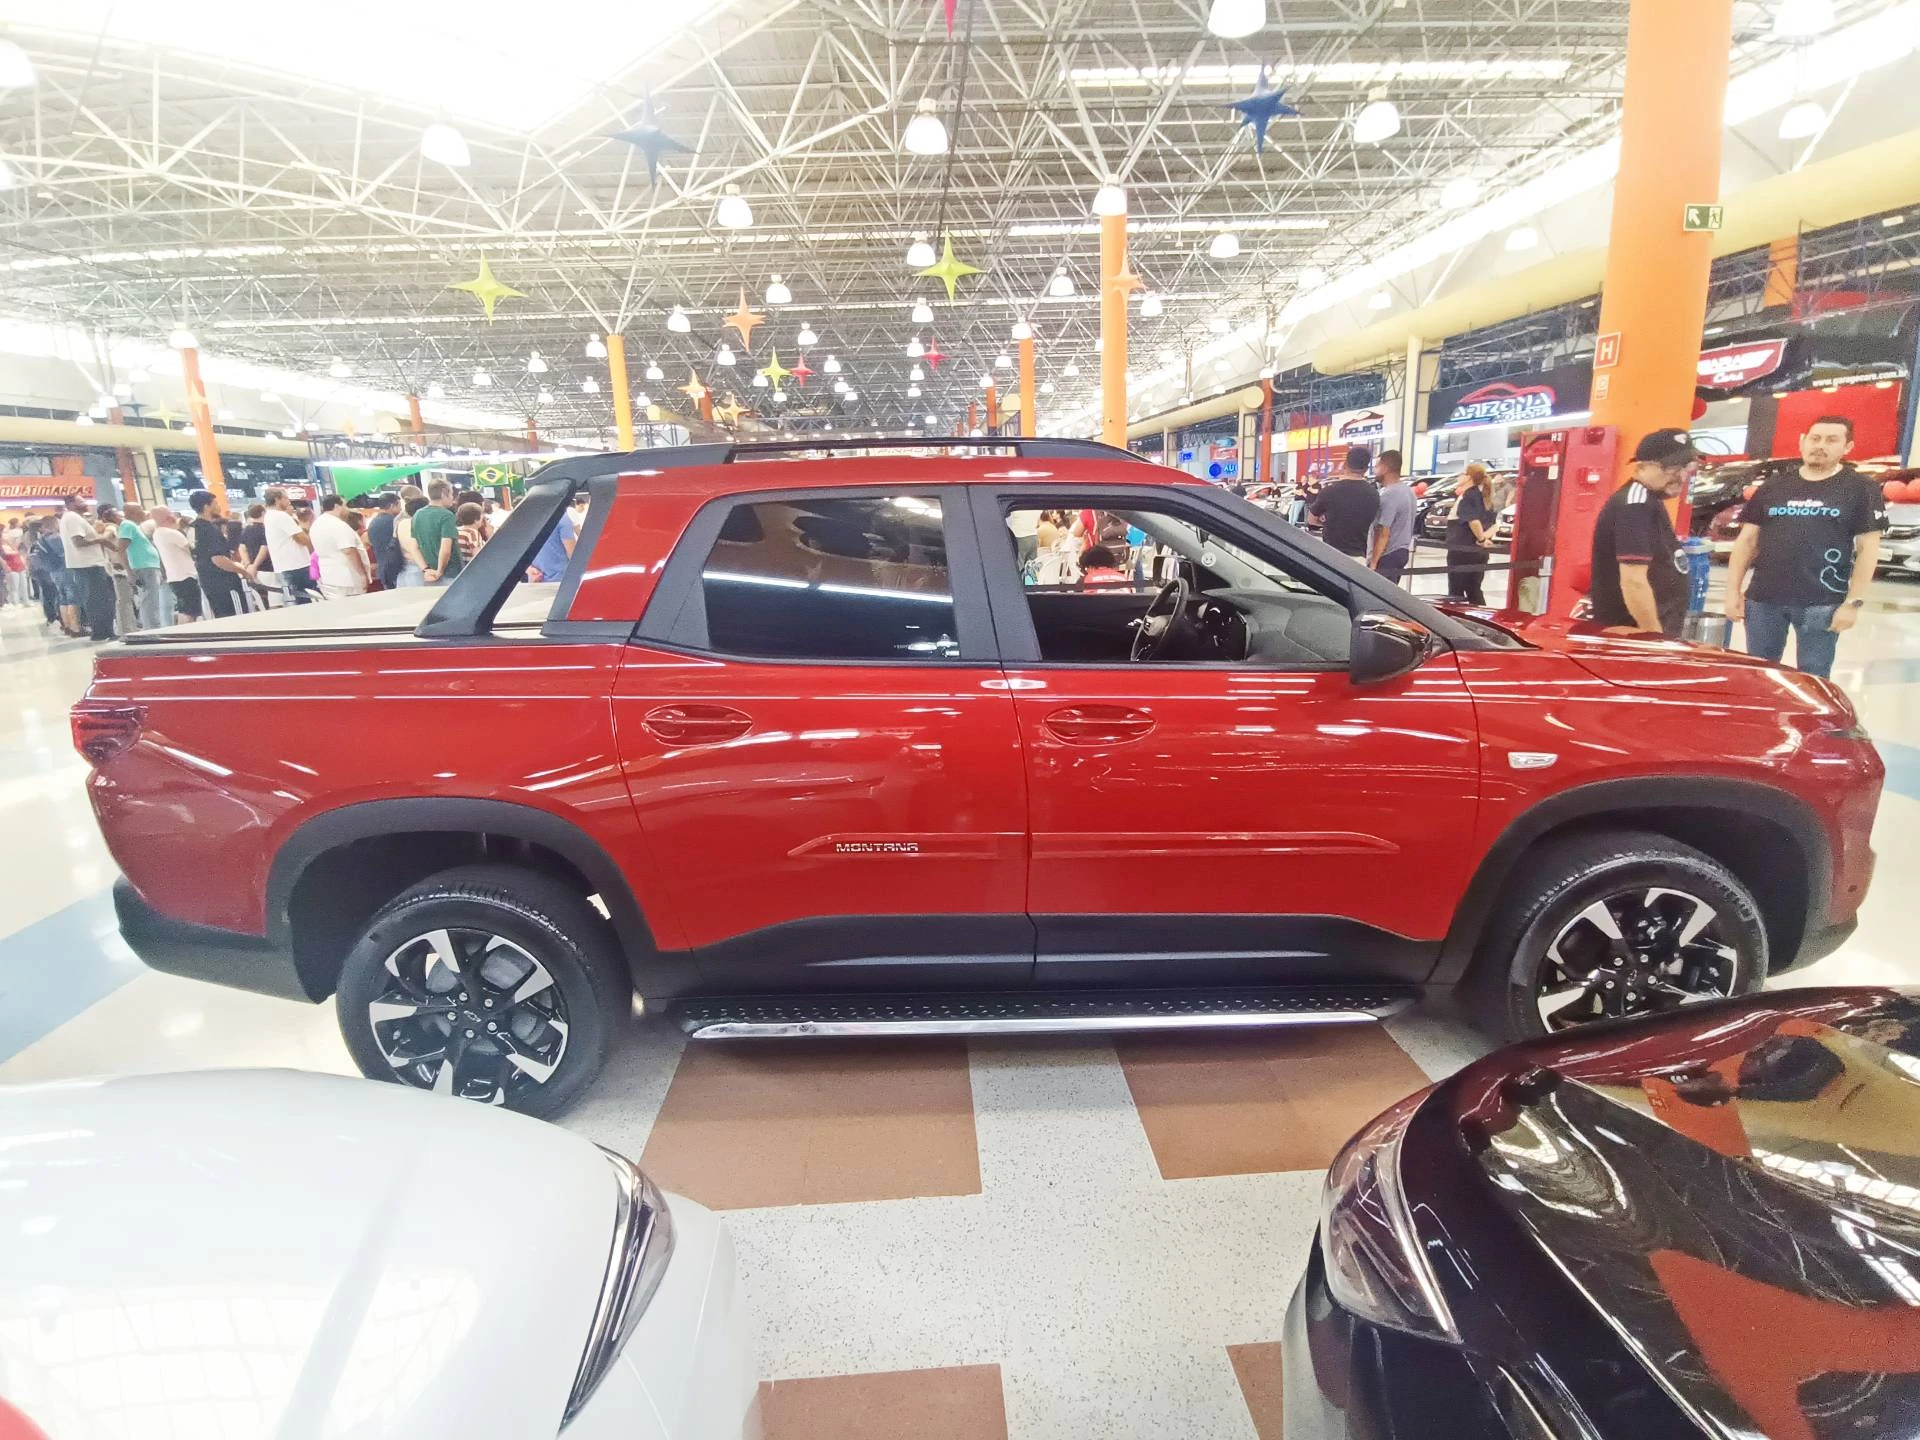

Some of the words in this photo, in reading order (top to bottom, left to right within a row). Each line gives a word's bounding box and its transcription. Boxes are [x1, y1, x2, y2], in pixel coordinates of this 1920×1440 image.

[1600, 340, 1613, 360] H
[1449, 391, 1552, 421] ARIZONA
[836, 843, 919, 852] MONTANA
